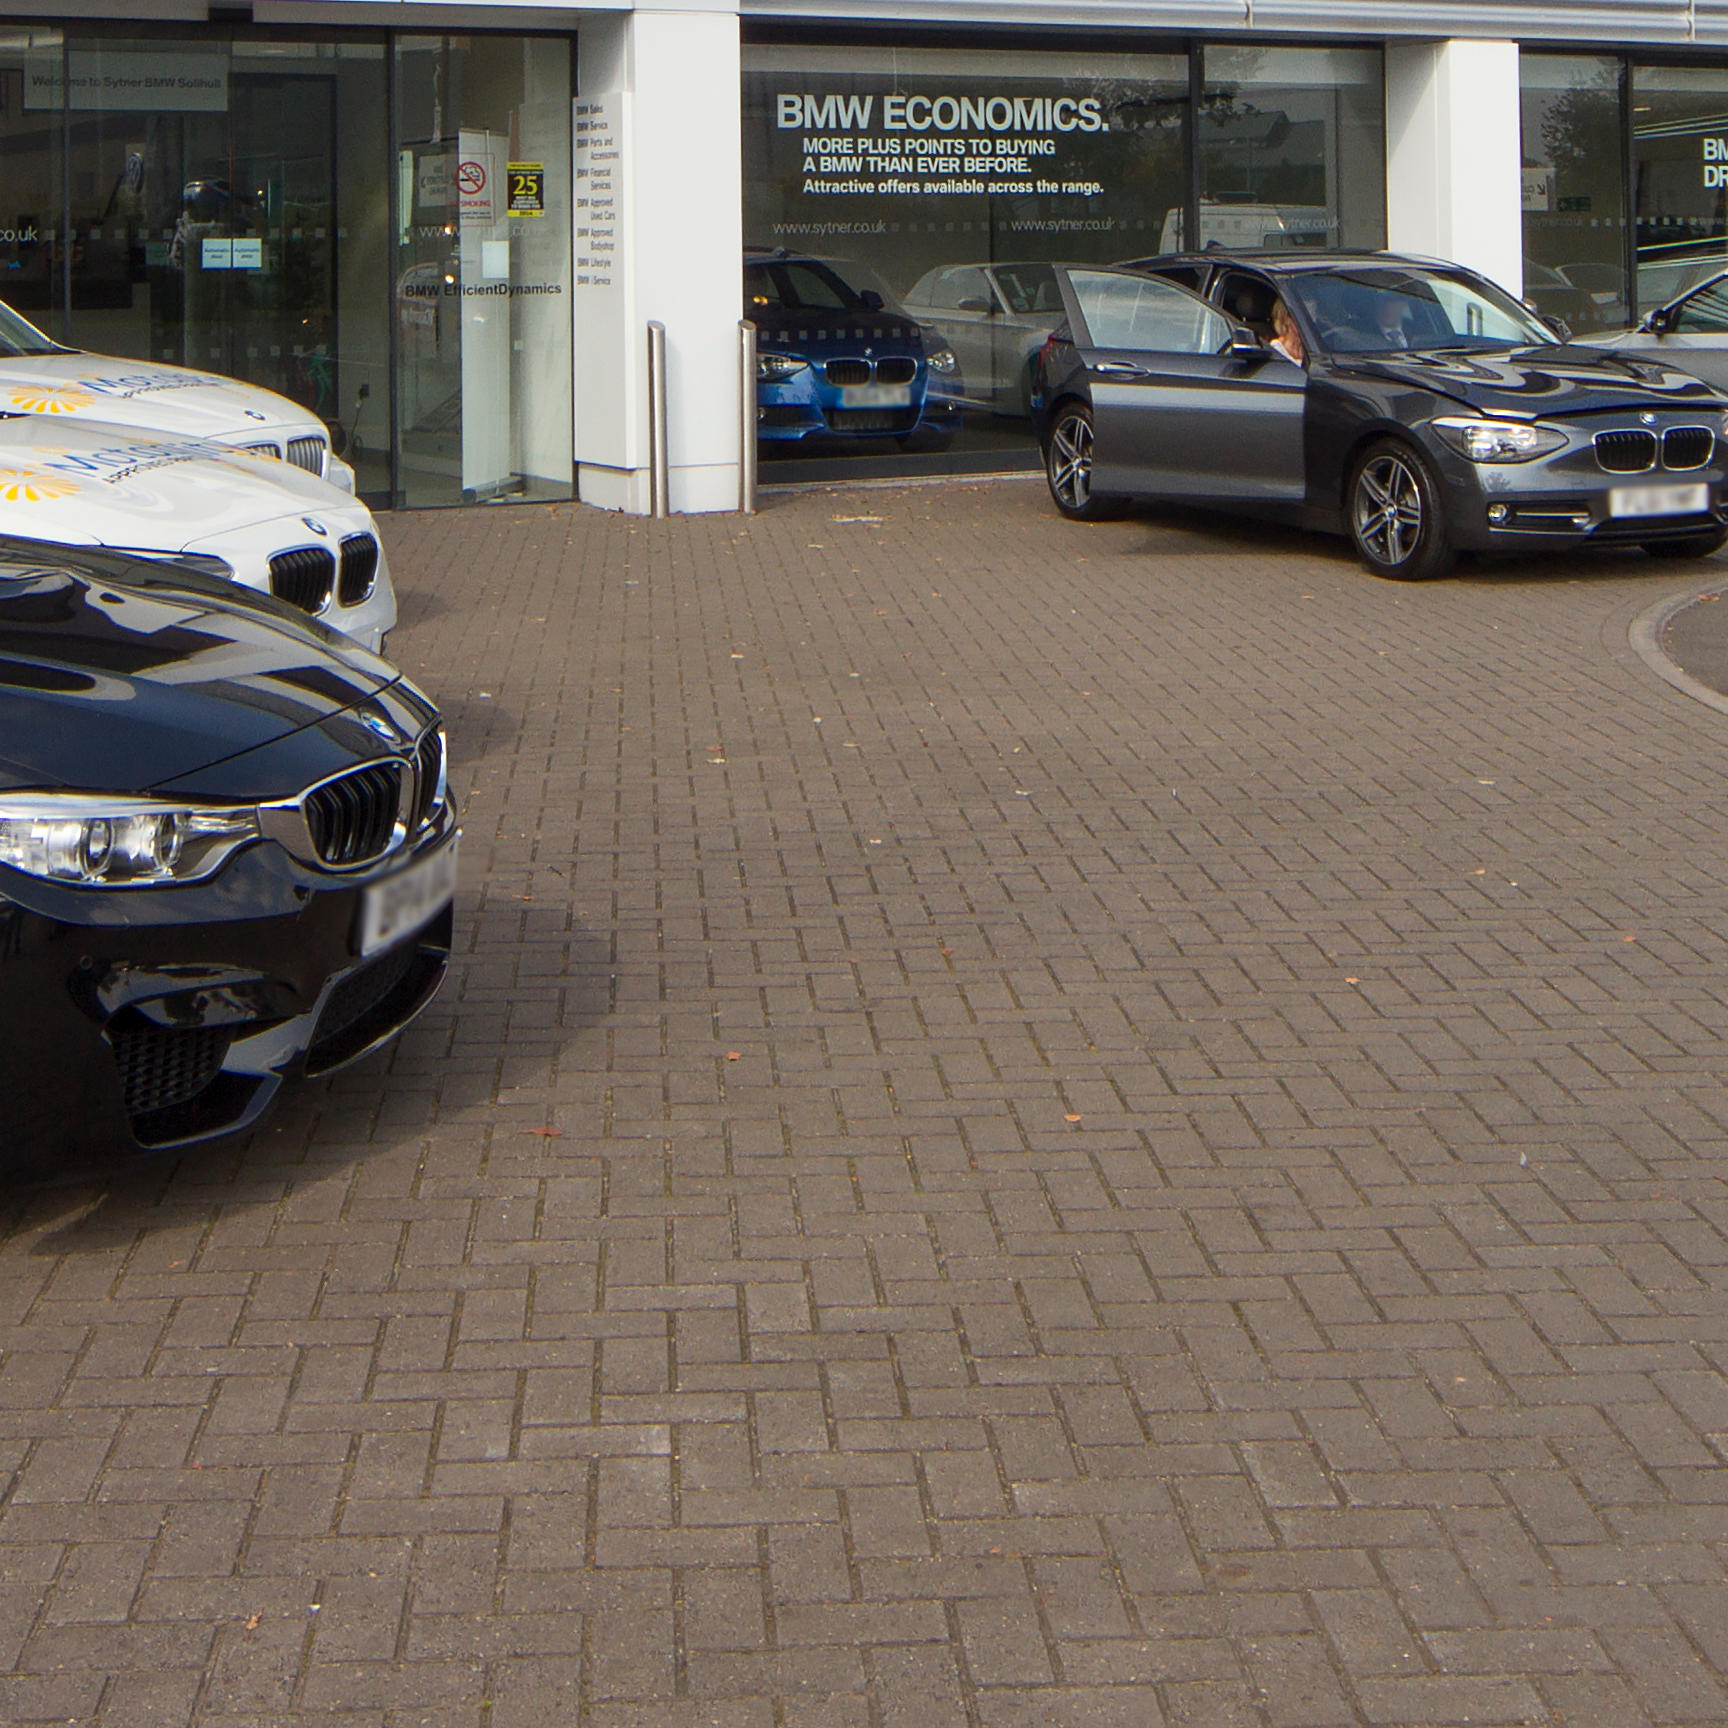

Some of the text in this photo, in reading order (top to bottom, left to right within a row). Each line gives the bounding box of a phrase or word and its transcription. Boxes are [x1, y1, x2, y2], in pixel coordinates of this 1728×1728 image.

[104, 77, 141, 89] Sytner
[144, 78, 176, 87] BMW
[777, 94, 1110, 132] BMW ECONOMICS.
[803, 138, 1055, 156] MORE PLUS POINTS TO BUYING
[803, 157, 1032, 174] A BMW THAN EVER BEFORE.
[513, 175, 538, 195] 25
[803, 179, 1104, 196] Attractive offers available across the range.
[772, 219, 888, 236] www.sytner.co.uk
[1011, 217, 1115, 234] www.sytner.co.uk
[405, 282, 562, 298] BMW EfficientDynamics
